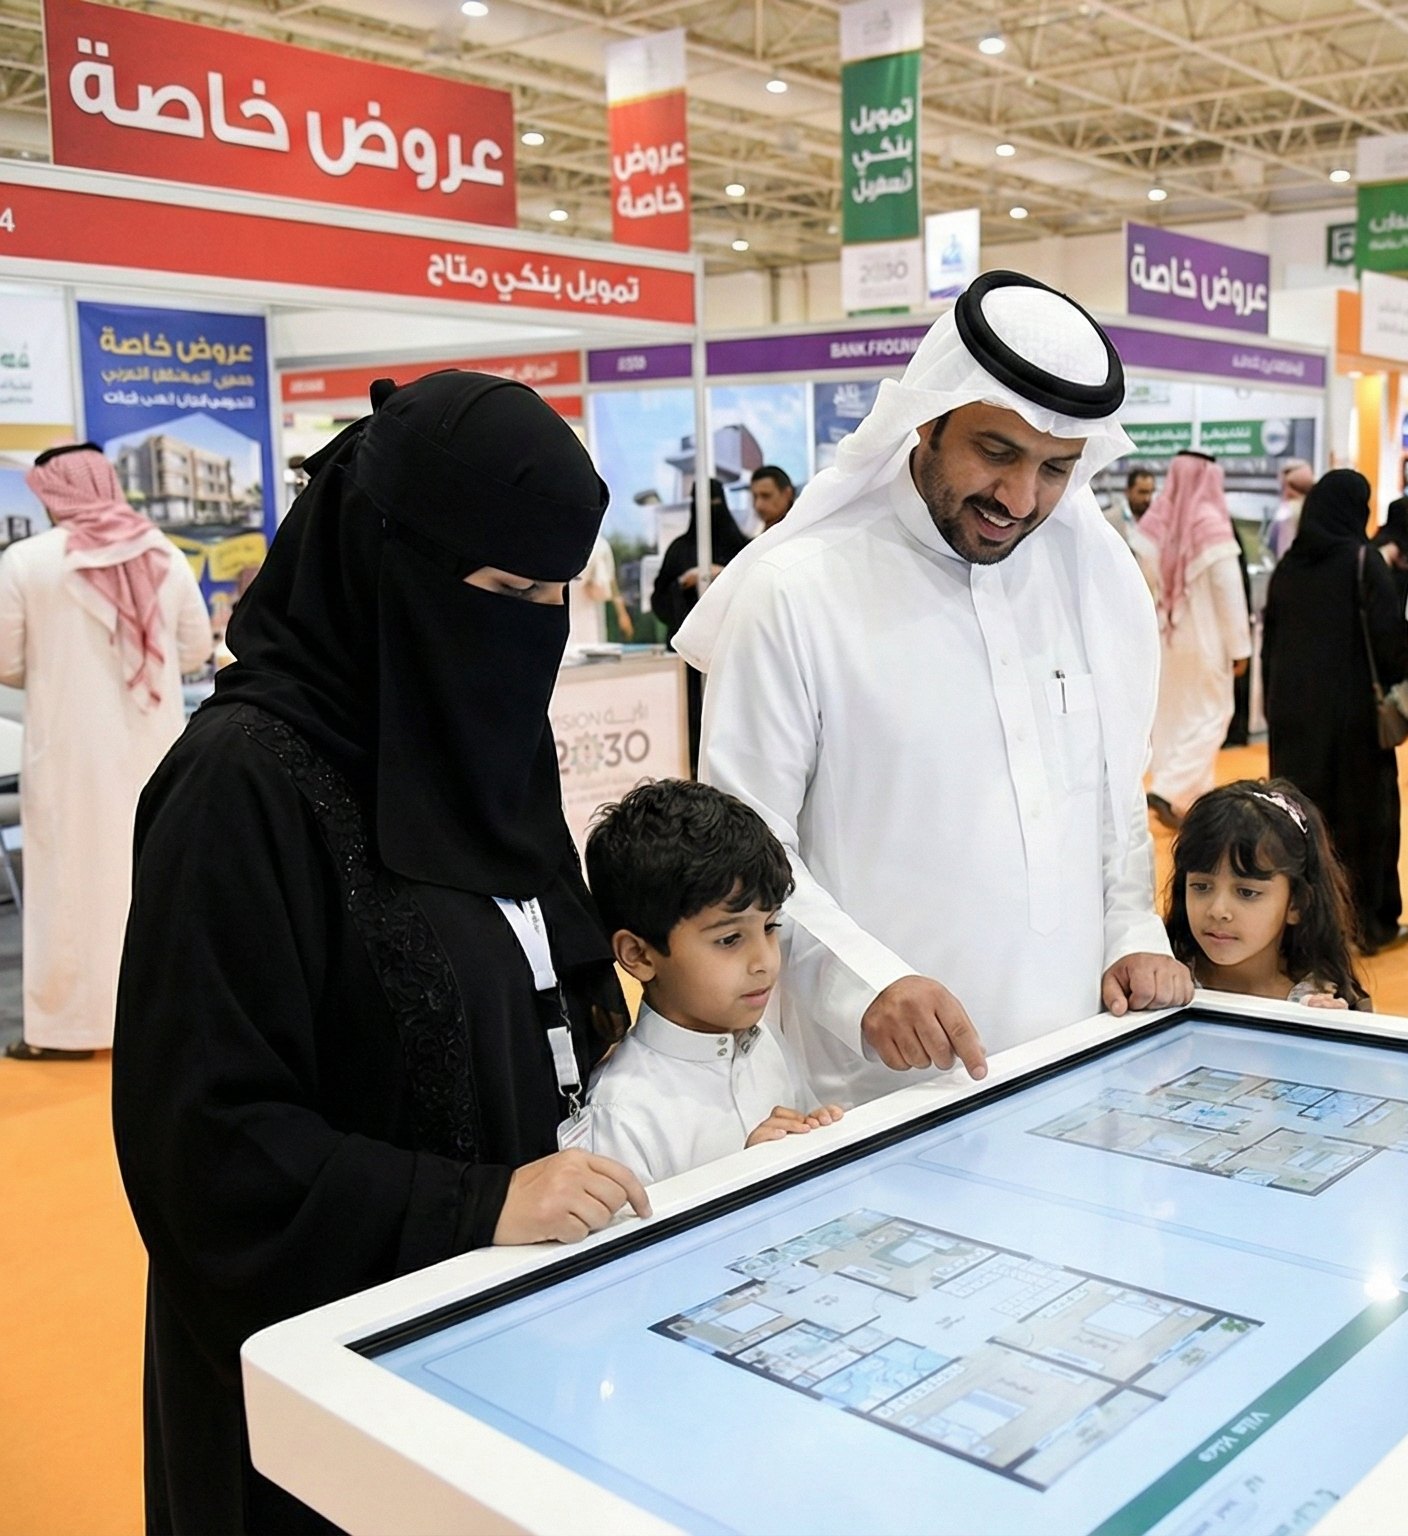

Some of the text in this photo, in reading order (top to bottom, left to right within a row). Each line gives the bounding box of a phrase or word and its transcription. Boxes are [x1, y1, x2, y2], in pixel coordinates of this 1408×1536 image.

[69, 37, 504, 193] عروض خاصة
[850, 97, 913, 135] تمويل
[613, 141, 686, 181] عروض
[851, 134, 913, 175] بنكي
[617, 182, 686, 218] خاصة
[427, 253, 640, 305] تمويل بنكي متاح
[1130, 243, 1268, 316] عروض خاصة
[100, 325, 253, 365] عروض خاصة
